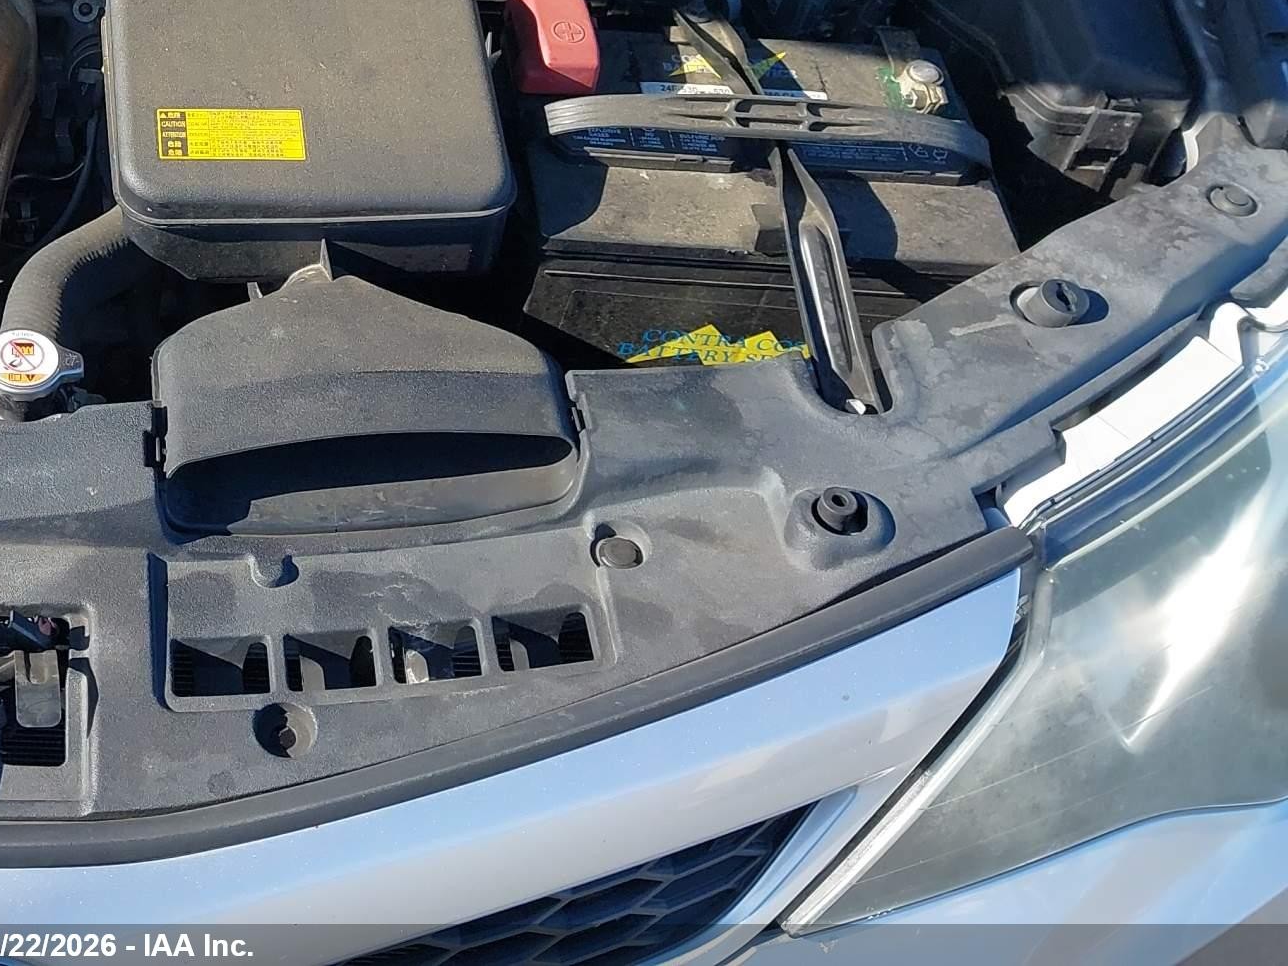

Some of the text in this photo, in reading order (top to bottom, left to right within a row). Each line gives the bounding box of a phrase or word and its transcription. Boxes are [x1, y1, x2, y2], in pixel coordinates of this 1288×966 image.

[161, 120, 186, 129] CAUTION
[642, 329, 746, 349] CONTRA
[617, 341, 737, 362] BATTERY
